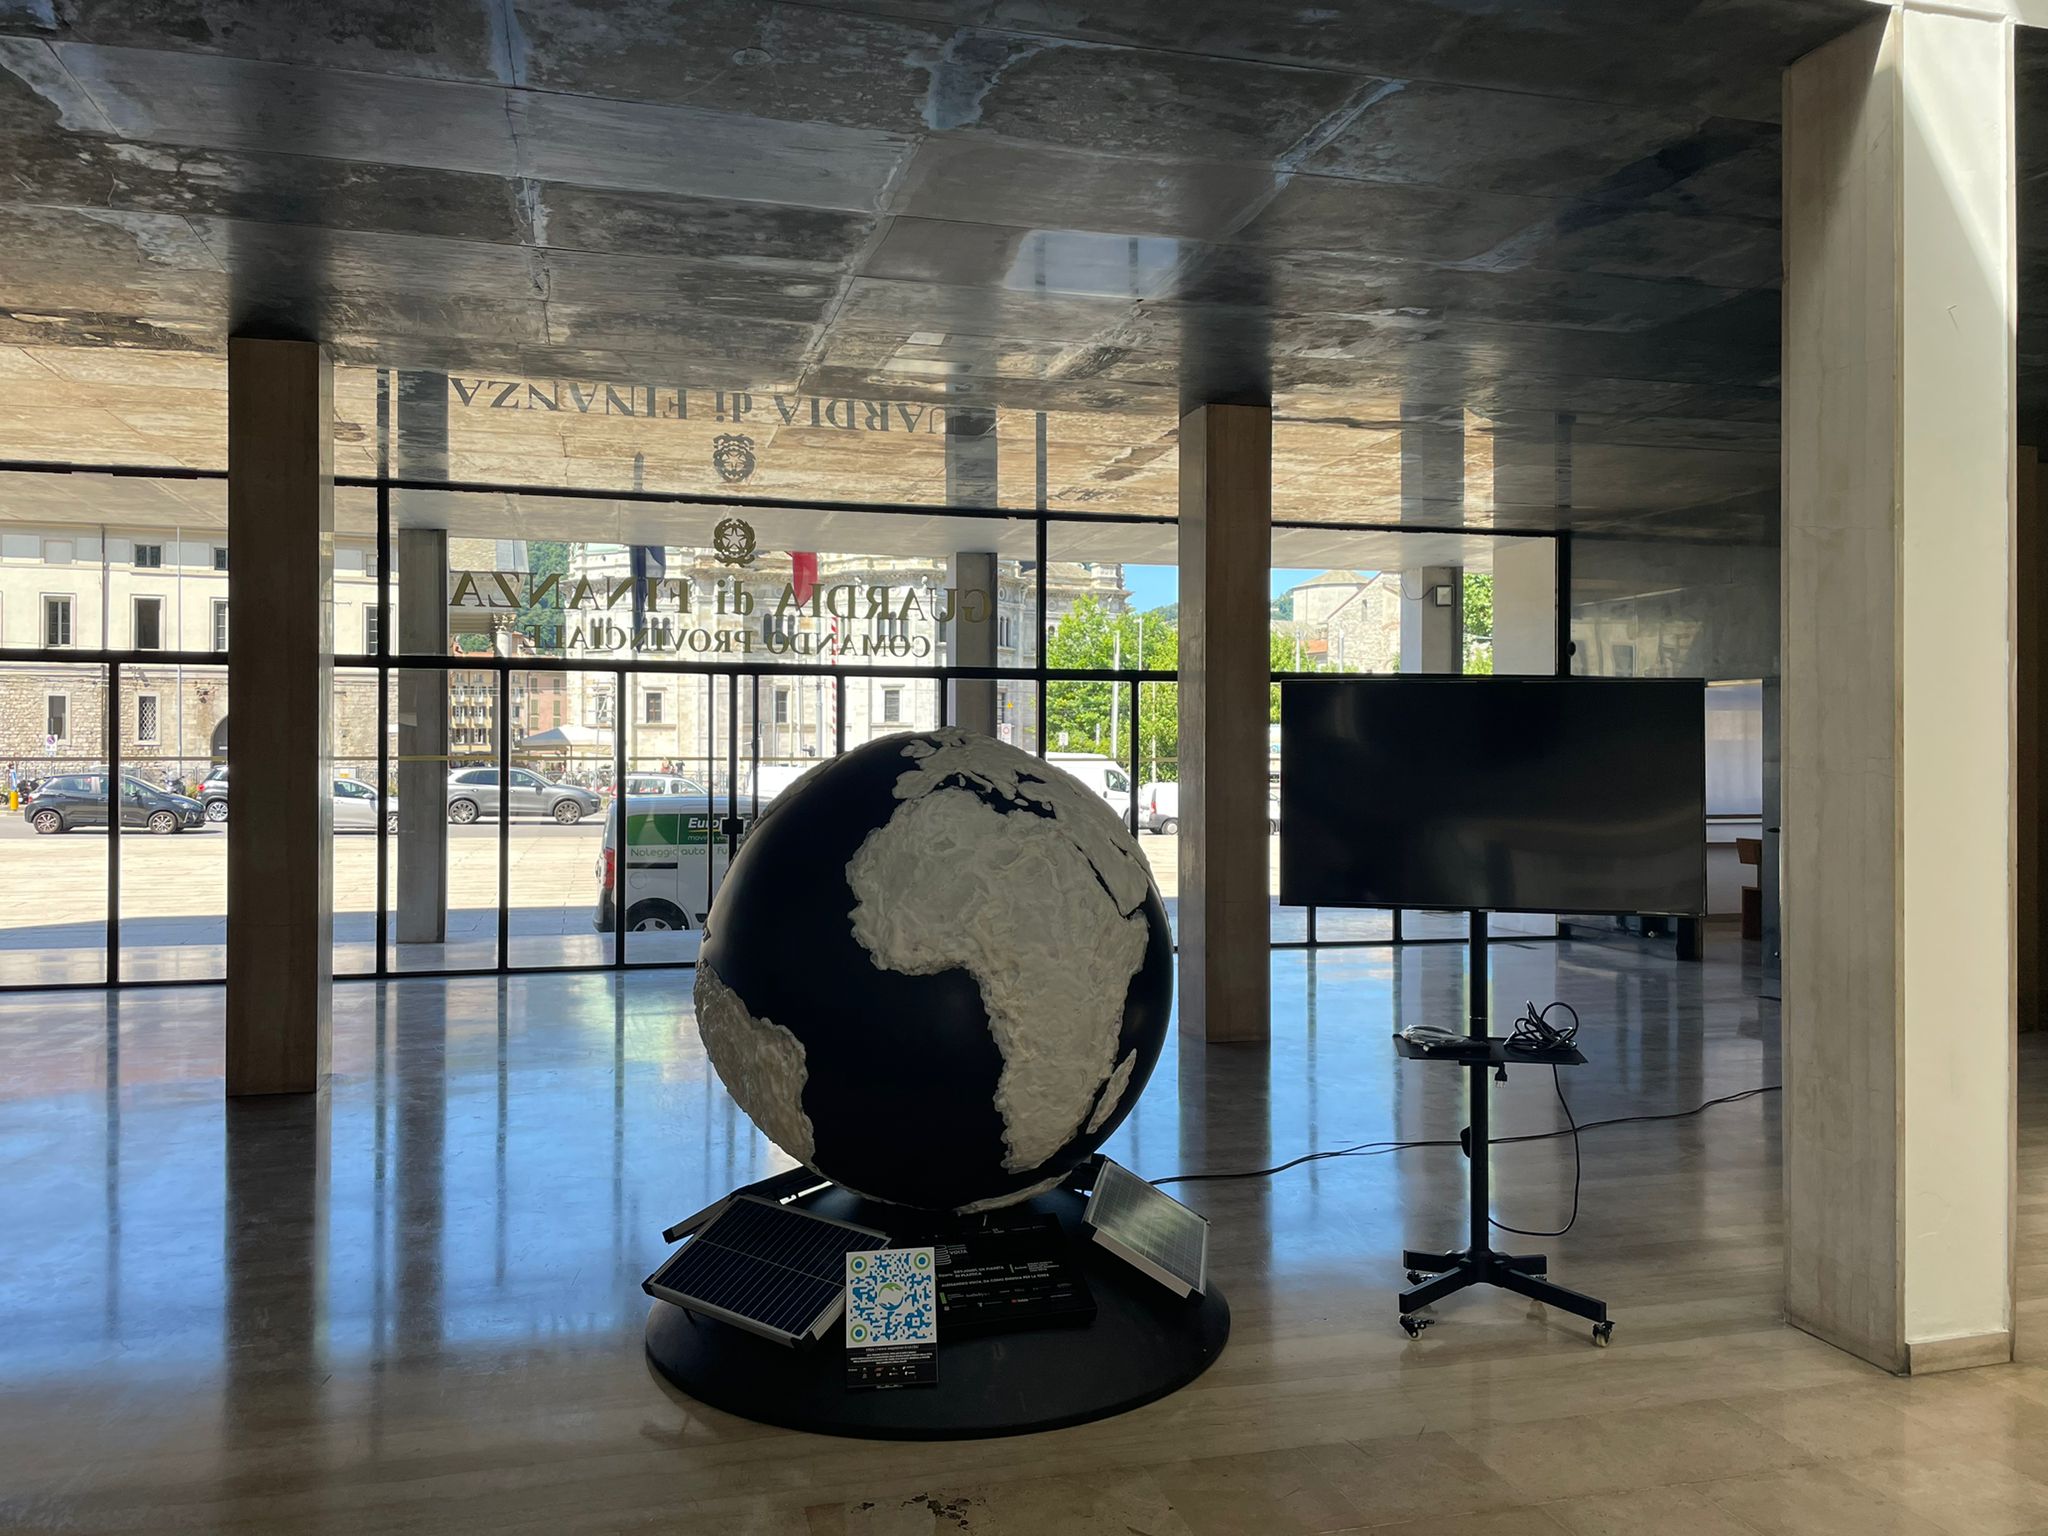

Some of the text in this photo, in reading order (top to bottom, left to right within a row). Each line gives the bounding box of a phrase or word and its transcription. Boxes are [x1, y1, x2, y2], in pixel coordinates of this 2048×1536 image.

[449, 377, 688, 419] FINANZA
[630, 847, 706, 858] Noleggio auto
